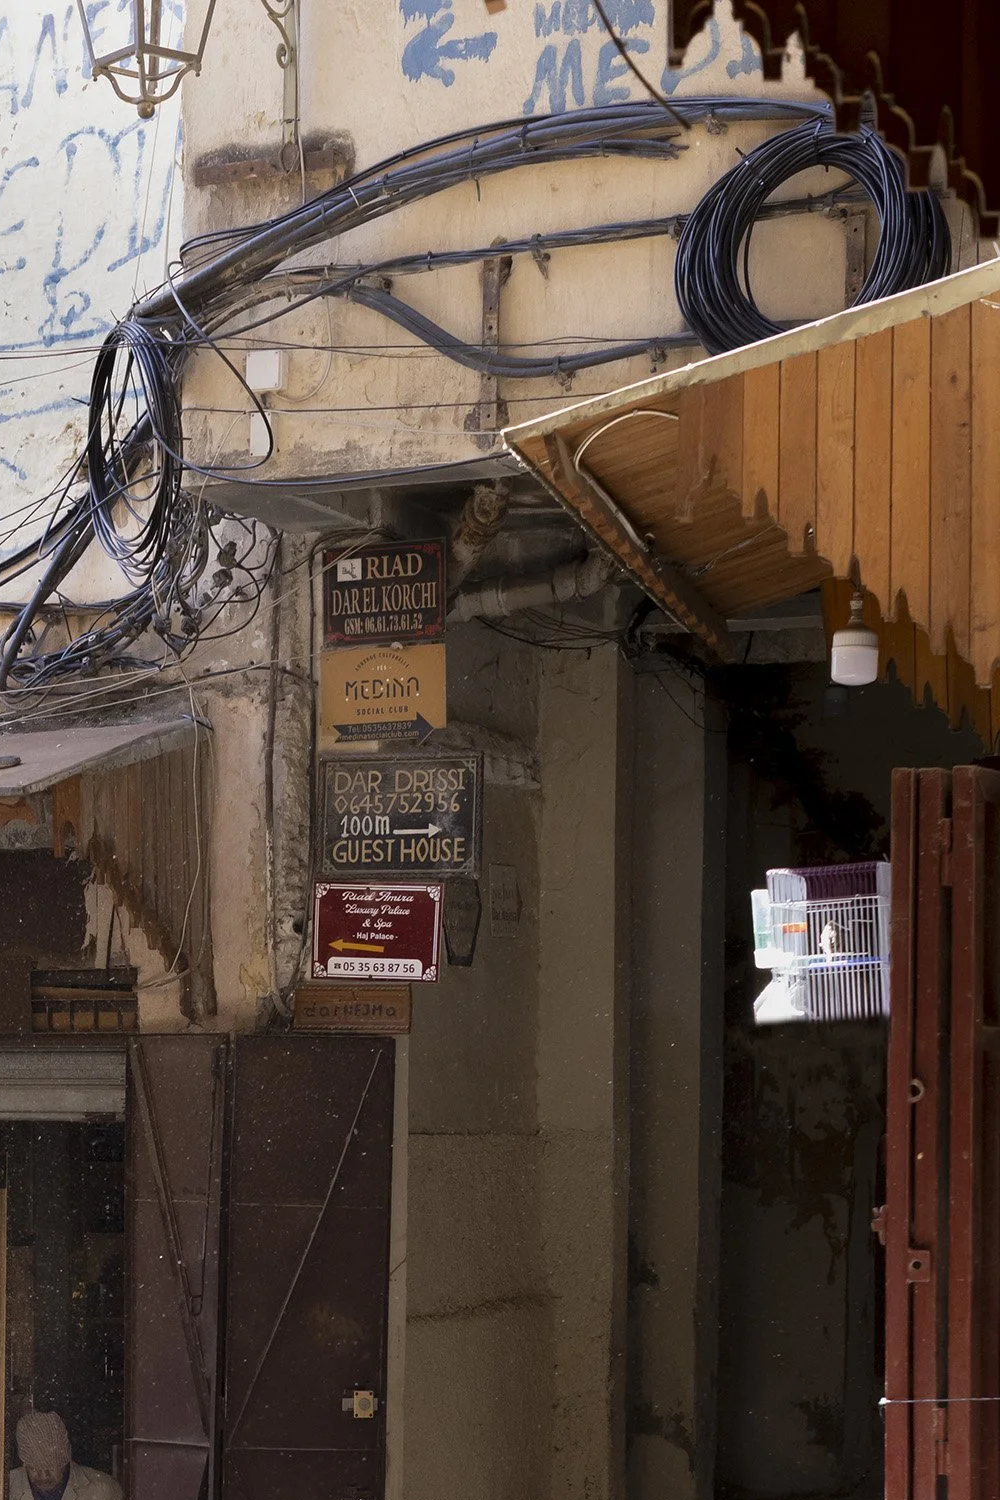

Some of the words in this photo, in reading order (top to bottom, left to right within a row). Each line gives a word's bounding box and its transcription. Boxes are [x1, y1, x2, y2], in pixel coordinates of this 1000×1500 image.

[366, 553, 423, 579] RIAD
[332, 588, 361, 616] DAR
[362, 587, 380, 613] EL
[381, 581, 437, 612] KORCHI
[344, 617, 364, 635] GSM:
[364, 612, 423, 633] 06.61.73.61.52
[345, 677, 420, 702] MEDINA
[356, 707, 385, 716] SOCIAL
[389, 705, 409, 714] CLUB
[334, 771, 382, 794] DAR
[394, 768, 466, 793] DRISSI
[334, 792, 460, 814] 0645752956
[332, 839, 396, 863] GUEST
[400, 838, 466, 863] HOUSE
[342, 890, 376, 901] Riad
[375, 890, 415, 902] Amira
[345, 903, 379, 917] Luxury
[380, 904, 411, 915] Palace
[362, 918, 371, 928] &
[373, 918, 393, 930] Spa
[356, 932, 369, 940] Haj
[370, 932, 395, 940] Palace
[343, 962, 355, 972] 05
[358, 962, 370, 972] 35
[373, 963, 385, 973] 63
[387, 963, 400, 973] 87
[403, 964, 415, 974] 56
